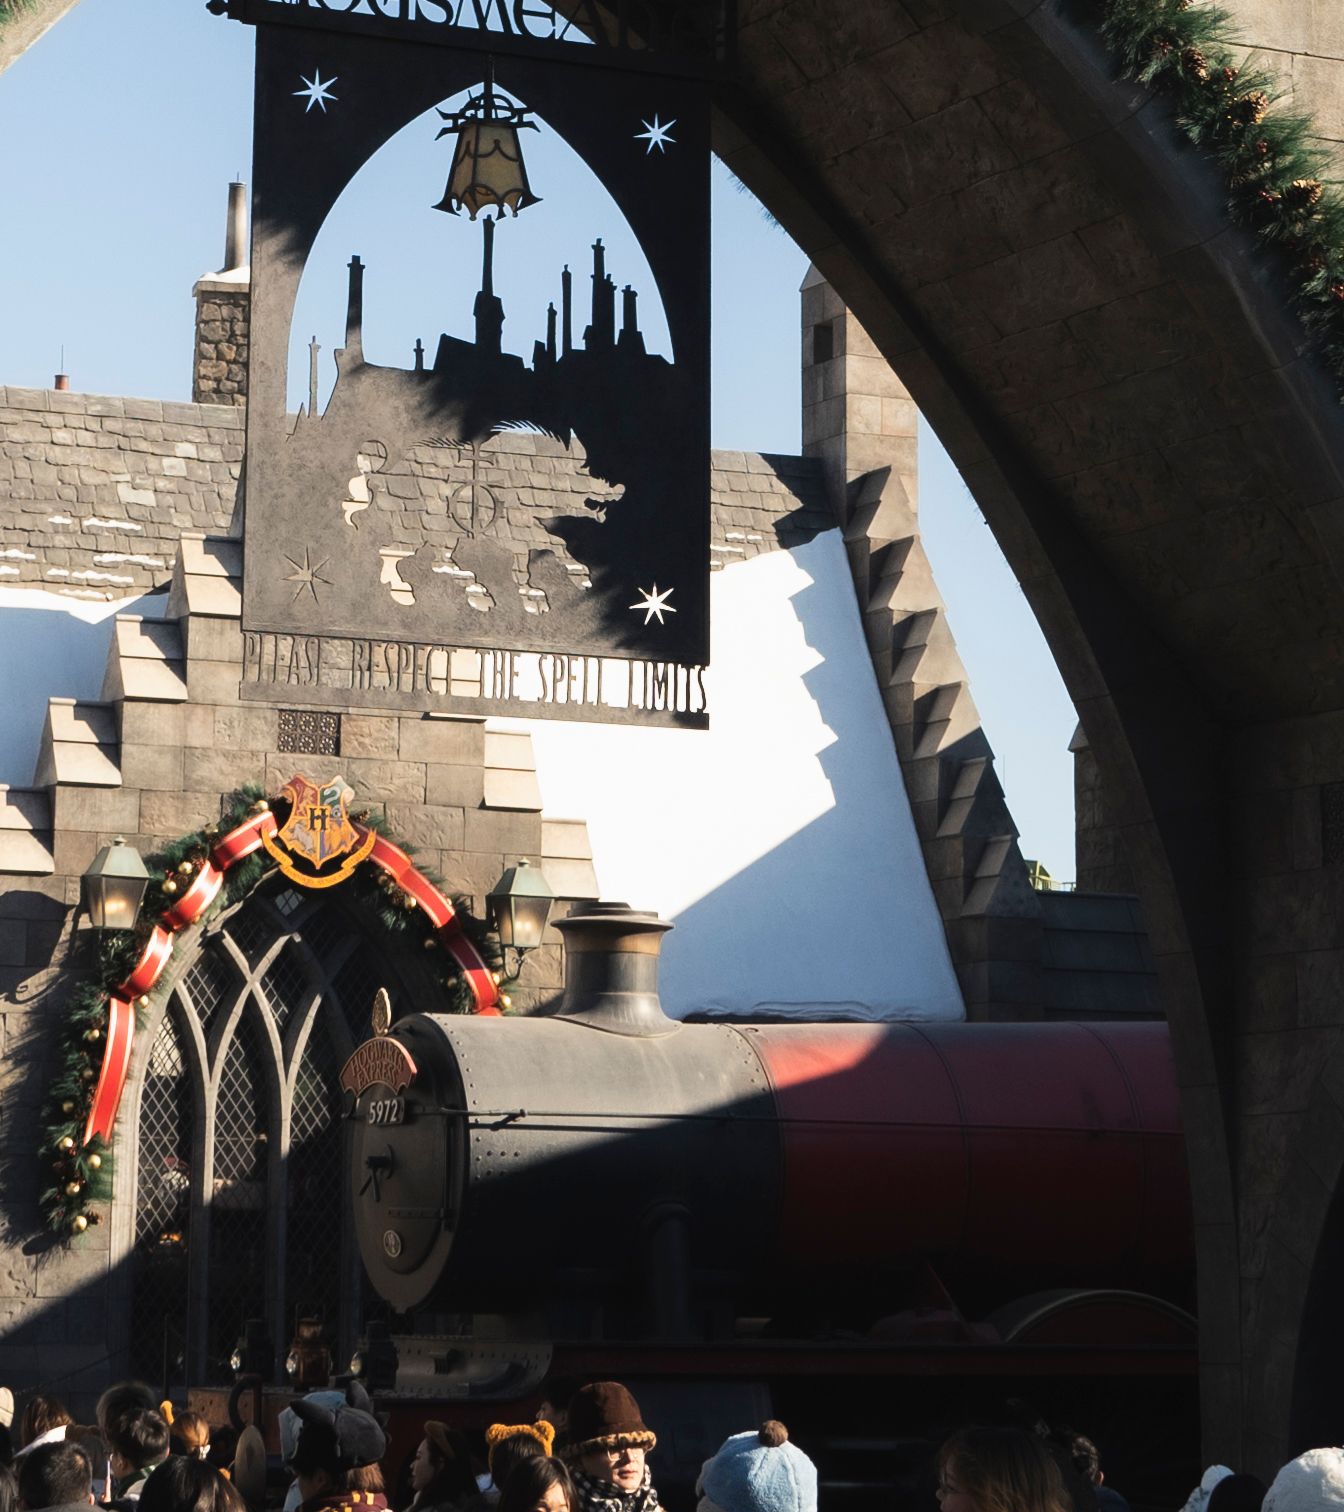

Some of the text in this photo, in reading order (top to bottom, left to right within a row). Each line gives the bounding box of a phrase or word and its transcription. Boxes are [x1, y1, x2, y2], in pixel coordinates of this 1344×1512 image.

[242, 632, 707, 714] PLEASE RESPECT THE SPELL LIMITS
[308, 807, 329, 832] H
[350, 1040, 404, 1076] HOGWARTS
[356, 1060, 398, 1089] EXPRESS
[368, 1098, 399, 1125] 5972
